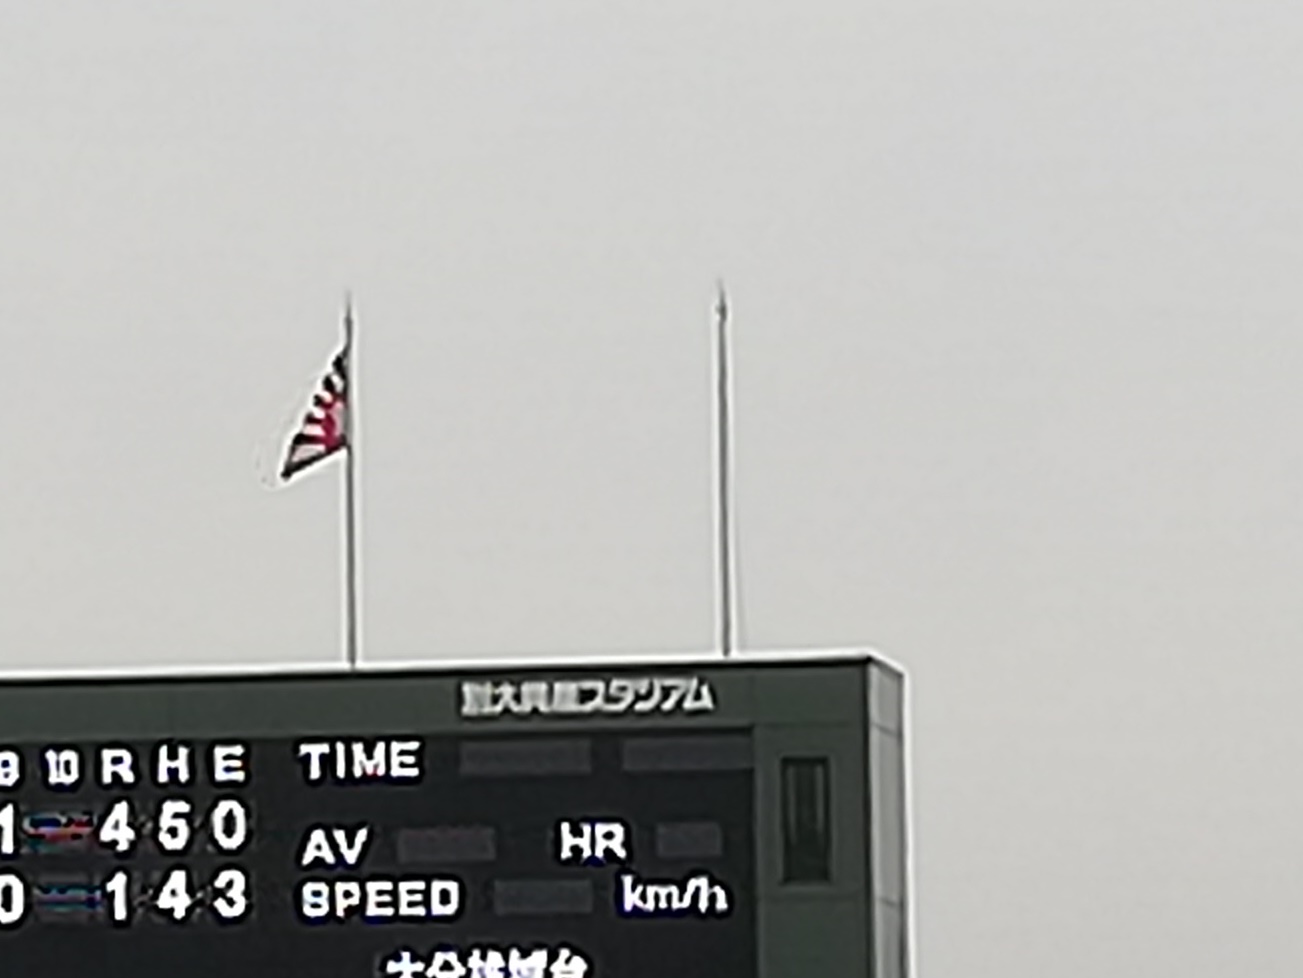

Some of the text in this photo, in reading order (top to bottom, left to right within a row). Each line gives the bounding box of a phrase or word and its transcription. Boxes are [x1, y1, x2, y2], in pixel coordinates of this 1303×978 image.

[46, 750, 78, 784] 10
[102, 749, 134, 783] R
[158, 745, 189, 782] H
[214, 745, 245, 781] E
[300, 741, 420, 779] TIME
[100, 801, 135, 851] 4
[212, 800, 245, 849] 0
[561, 822, 626, 859] HR
[302, 828, 367, 865] AV
[107, 872, 126, 920] 1
[156, 870, 191, 919] 4
[214, 870, 246, 917] 3
[303, 881, 458, 917] SPEED
[622, 875, 727, 912] km/h
